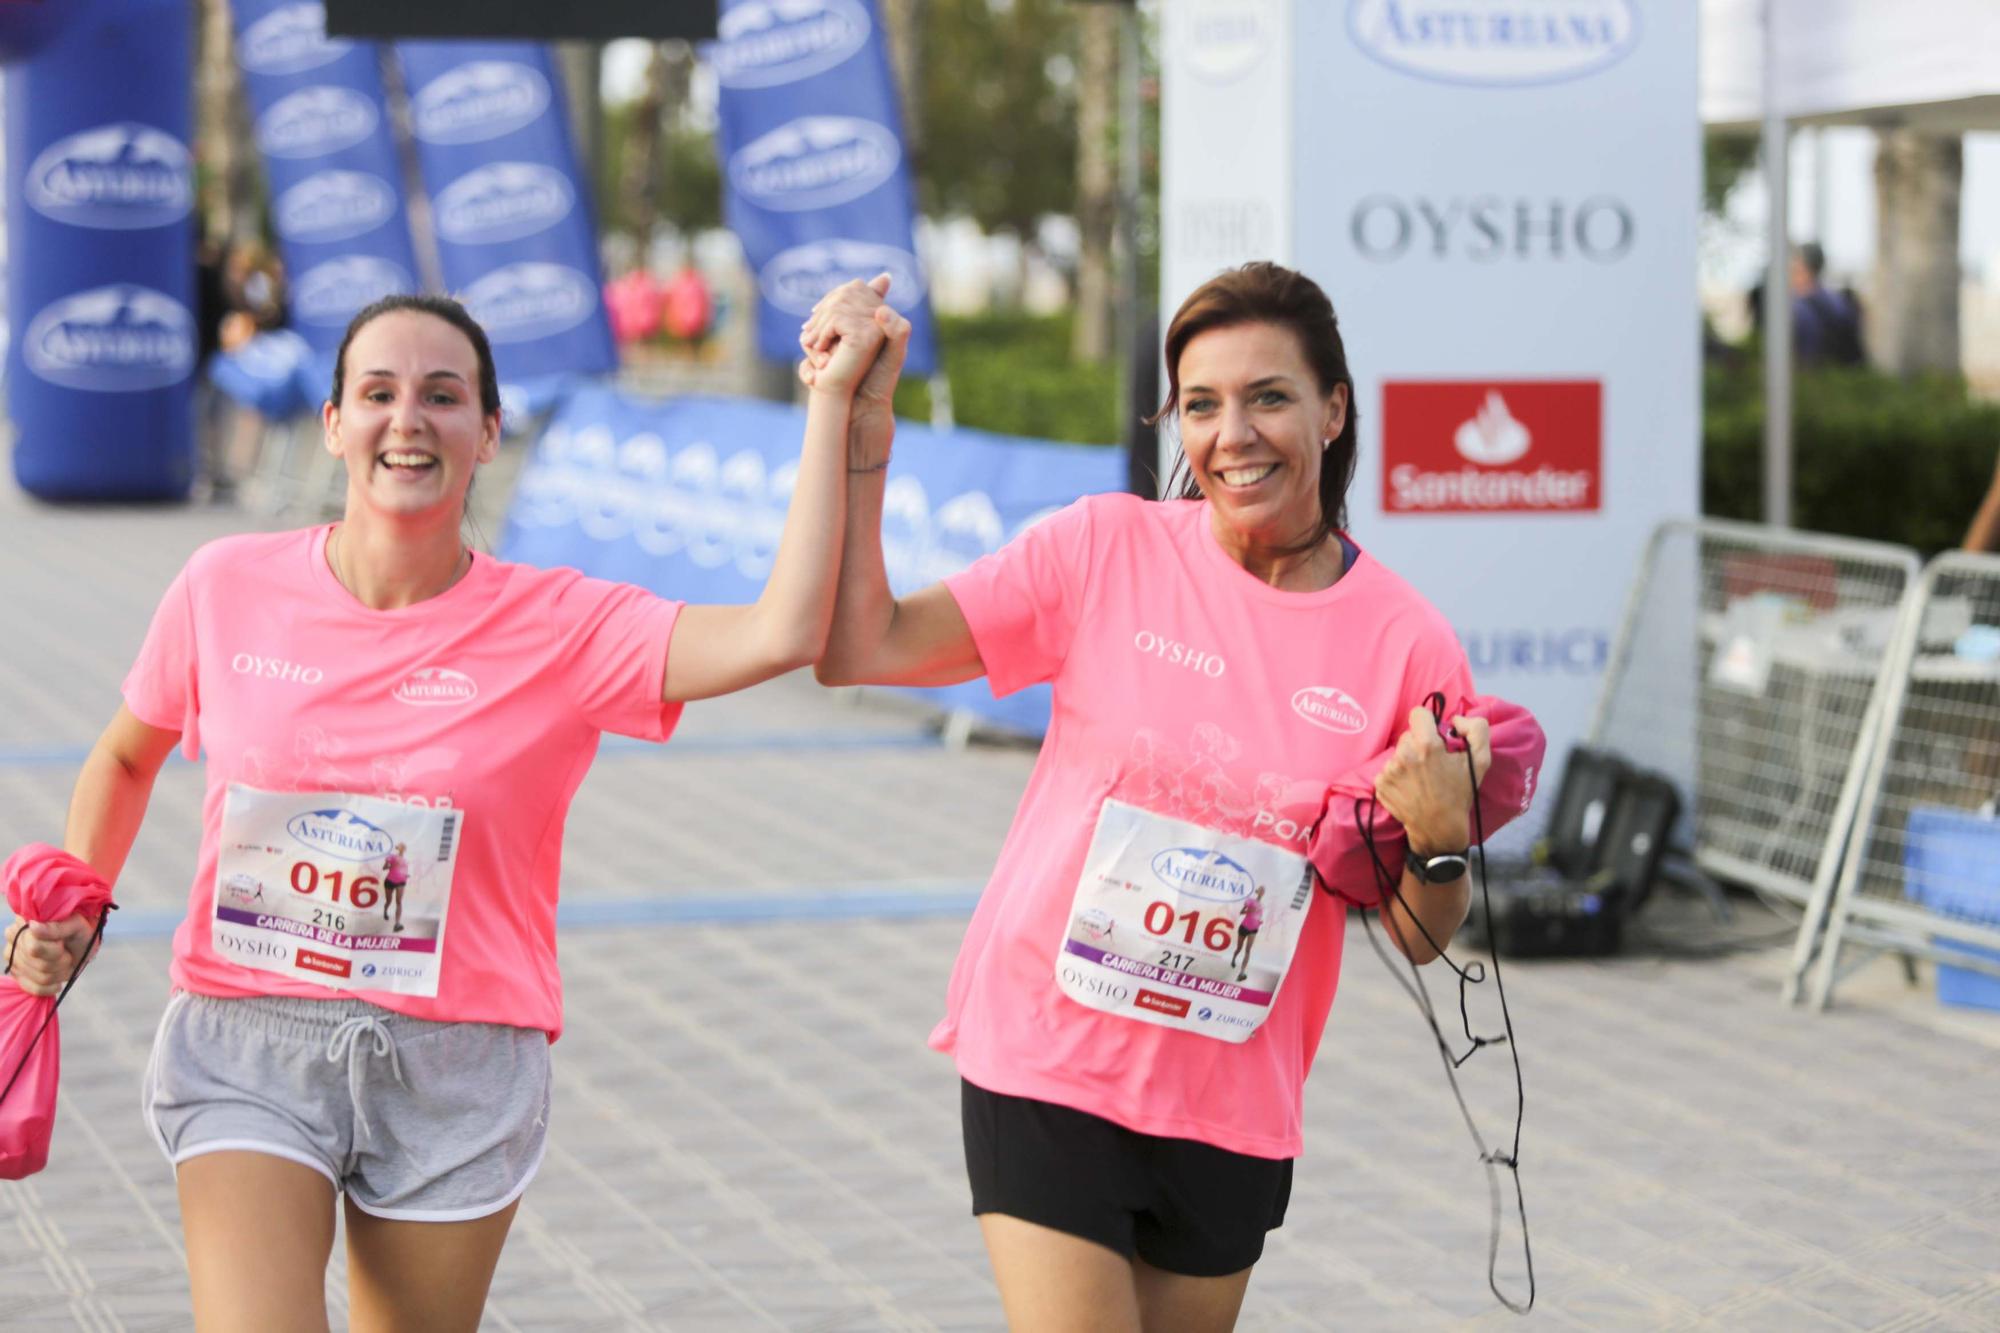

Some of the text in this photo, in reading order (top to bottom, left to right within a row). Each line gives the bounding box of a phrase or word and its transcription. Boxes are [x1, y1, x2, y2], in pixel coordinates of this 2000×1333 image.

[1372, 2, 1618, 52] ASTURIANA
[1348, 192, 1637, 262] OYSHO
[1390, 462, 1590, 508] Santander
[231, 652, 324, 686] OYSHO
[1134, 630, 1226, 679] OYSHO
[1466, 627, 1610, 676] URIC
[398, 678, 472, 698] ASTURIANA
[1296, 692, 1363, 728] ASTURIANA
[297, 819, 386, 855] ASTURIANA
[289, 860, 381, 910] 016
[1157, 854, 1246, 898] ASTURIANA
[255, 913, 401, 951] CARRERA DE LA MUJER
[312, 907, 346, 932] 216
[1142, 900, 1236, 953] 016
[219, 931, 288, 962] OYSHO
[311, 956, 345, 973] Santander
[1158, 950, 1196, 972] 217
[381, 966, 424, 979] ZURICH
[1062, 965, 1129, 1002] OYSHO
[1100, 952, 1242, 1001] CARRERA DE LA MUJER
[1149, 997, 1184, 1013] Santander
[1216, 1013, 1256, 1031] ZURICH
